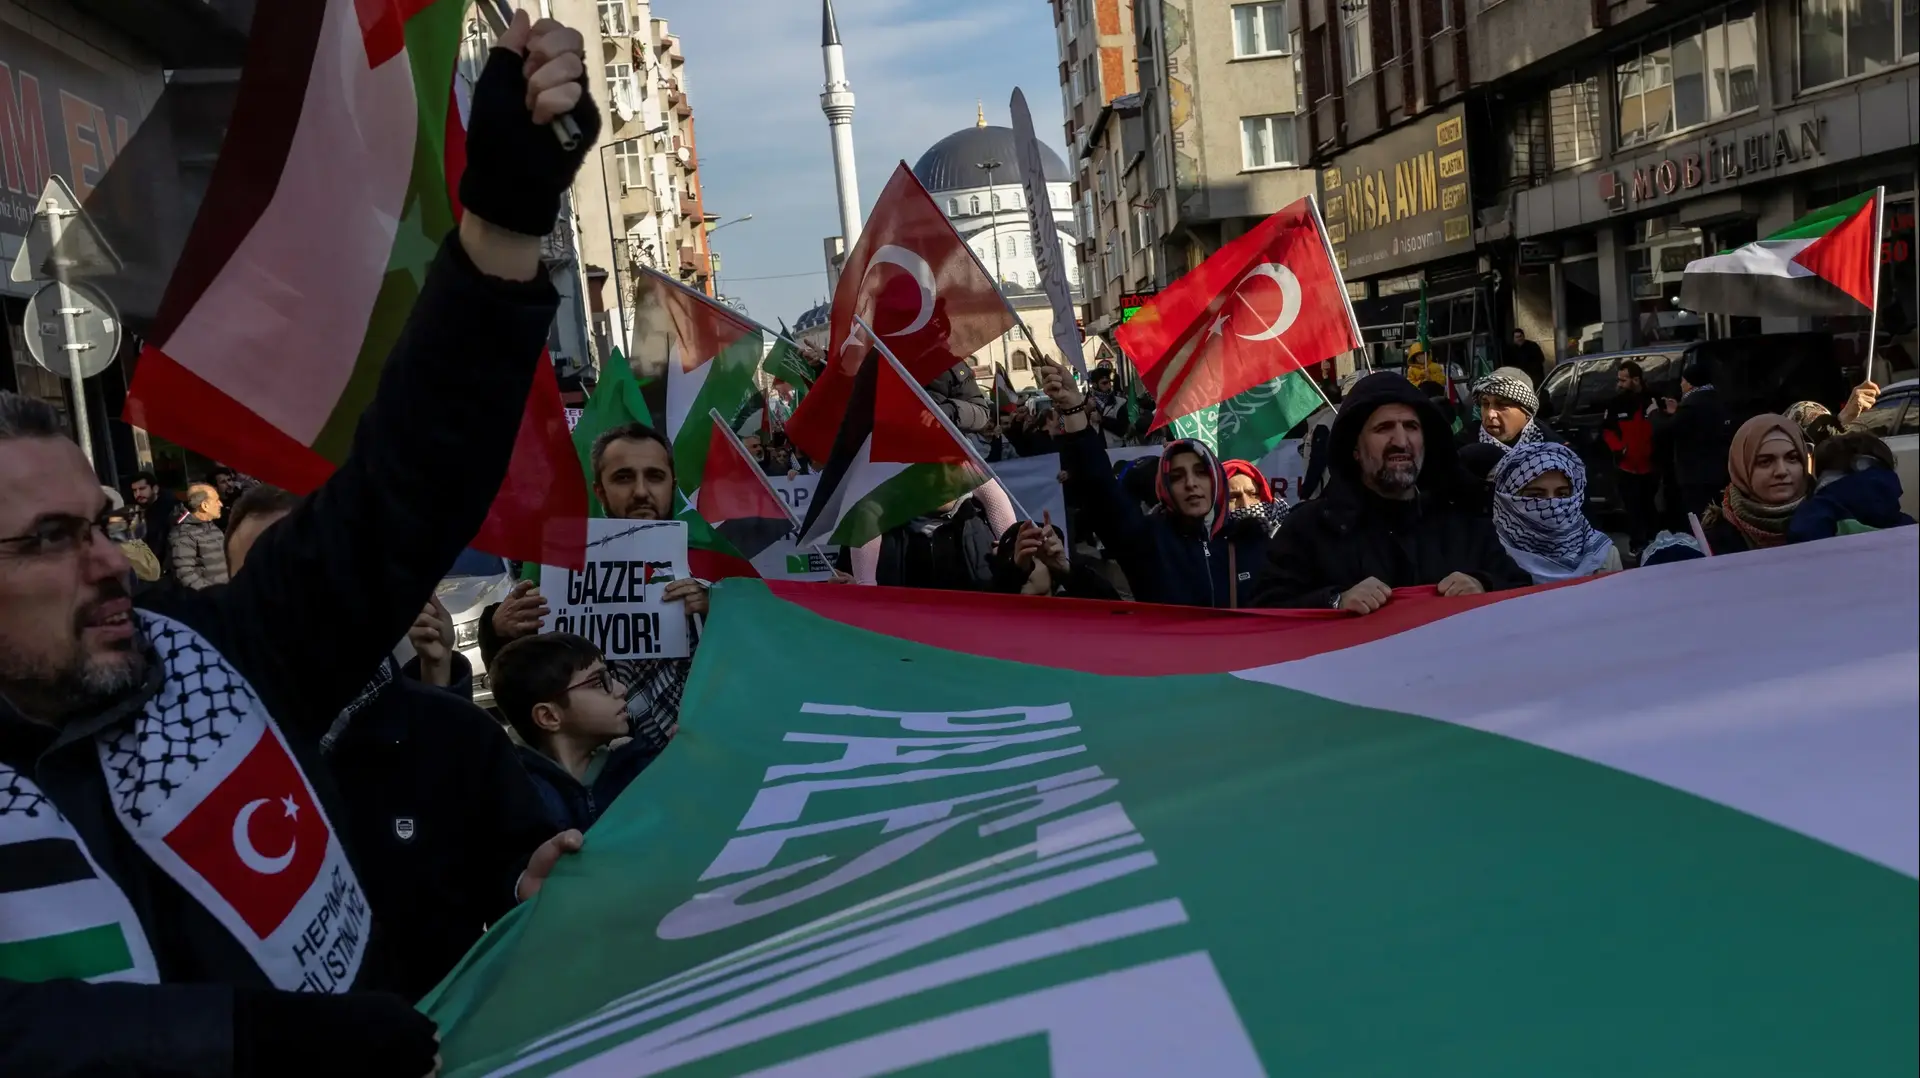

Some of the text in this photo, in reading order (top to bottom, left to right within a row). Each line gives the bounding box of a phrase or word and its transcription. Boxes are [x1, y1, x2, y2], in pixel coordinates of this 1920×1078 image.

[1345, 150, 1438, 235] NİSA AVM
[1632, 116, 1828, 204] MOBİLHAN
[567, 561, 644, 605] GAZZE
